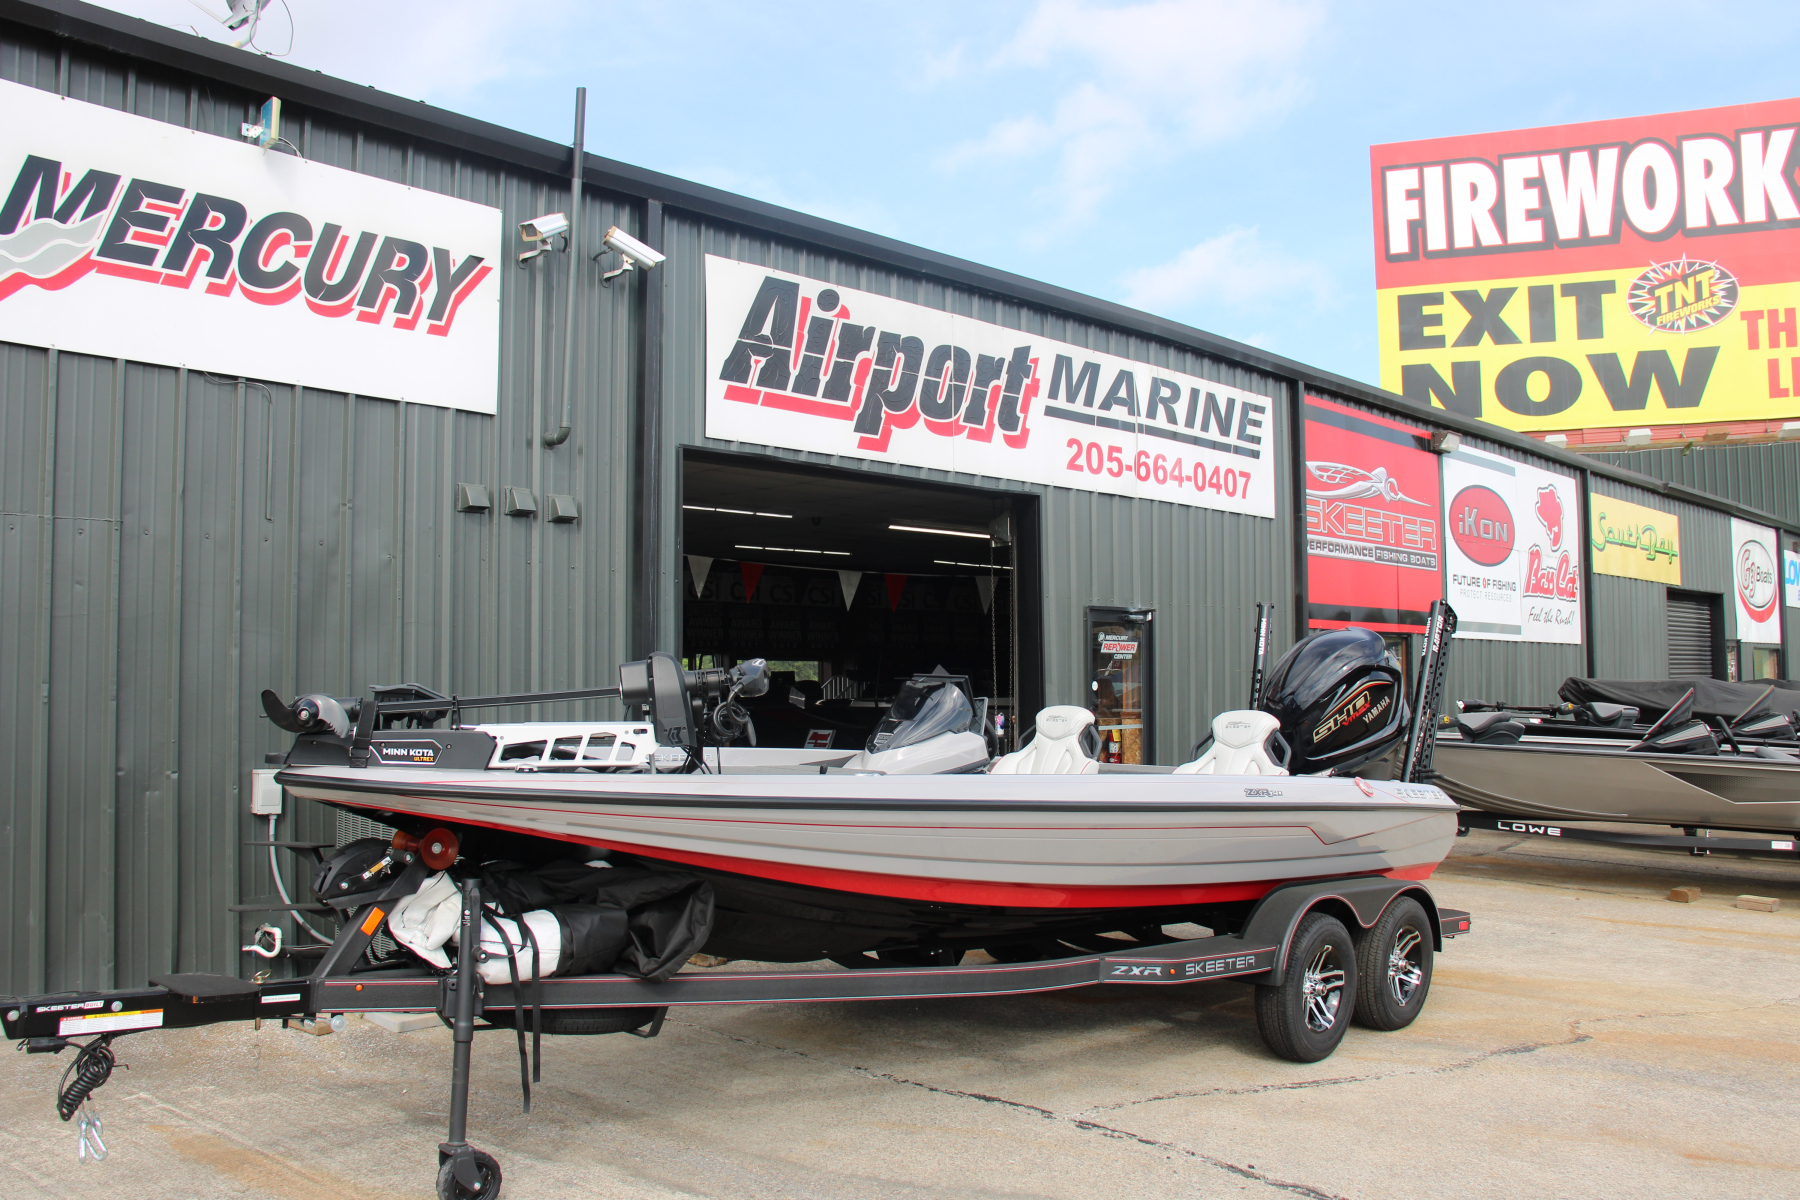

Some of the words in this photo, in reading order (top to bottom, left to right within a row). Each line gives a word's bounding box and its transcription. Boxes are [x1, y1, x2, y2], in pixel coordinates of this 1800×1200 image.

[0, 154, 490, 332] MERCURY
[1654, 268, 1716, 315] TNT
[1397, 279, 1617, 351] EXIT
[1657, 294, 1722, 326] FIREWORKS
[719, 276, 1036, 444] Airport
[1401, 345, 1721, 419] NOW
[1045, 353, 1266, 446] MARINE
[1065, 438, 1252, 500] 205-664-0407
[1306, 495, 1437, 551] SKEETER
[1592, 511, 1641, 552] South
[1641, 524, 1678, 565] Bay
[1308, 539, 1374, 558] ERFORMANCE
[1376, 549, 1408, 563] FISHING
[1410, 553, 1436, 566] BOATS
[1452, 574, 1480, 588] FUTURE
[1482, 577, 1491, 588] OF
[1492, 579, 1516, 591] FISHING
[1523, 543, 1556, 599] Bass
[1741, 548, 1756, 598] G3
[1756, 565, 1773, 585] Boats
[1460, 588, 1482, 599] PROTECT
[1484, 591, 1512, 602] RESOURCES
[688, 617, 722, 628] AWARD
[730, 618, 763, 629] AWARD
[769, 619, 801, 631] AWARD
[1260, 618, 1268, 637] MINN
[1528, 606, 1544, 624] Feel
[1543, 608, 1553, 623] the
[1554, 609, 1575, 626] Rush!
[686, 628, 724, 638] WINNER
[728, 629, 765, 640] WINNER
[768, 630, 802, 641] WINNER
[1258, 637, 1266, 655] KOTA
[1432, 614, 1444, 653] RAPTOR
[1313, 691, 1370, 743] SHO
[1363, 695, 1391, 723] YAMAHA
[382, 748, 407, 756] MINN
[409, 749, 434, 757] KOTA
[1497, 820, 1561, 837] LOWE
[1111, 965, 1162, 976] ZXR
[1185, 955, 1256, 976] SKEETER
[36, 1002, 85, 1013] SKEETER
[85, 1000, 104, 1008] BUILT
